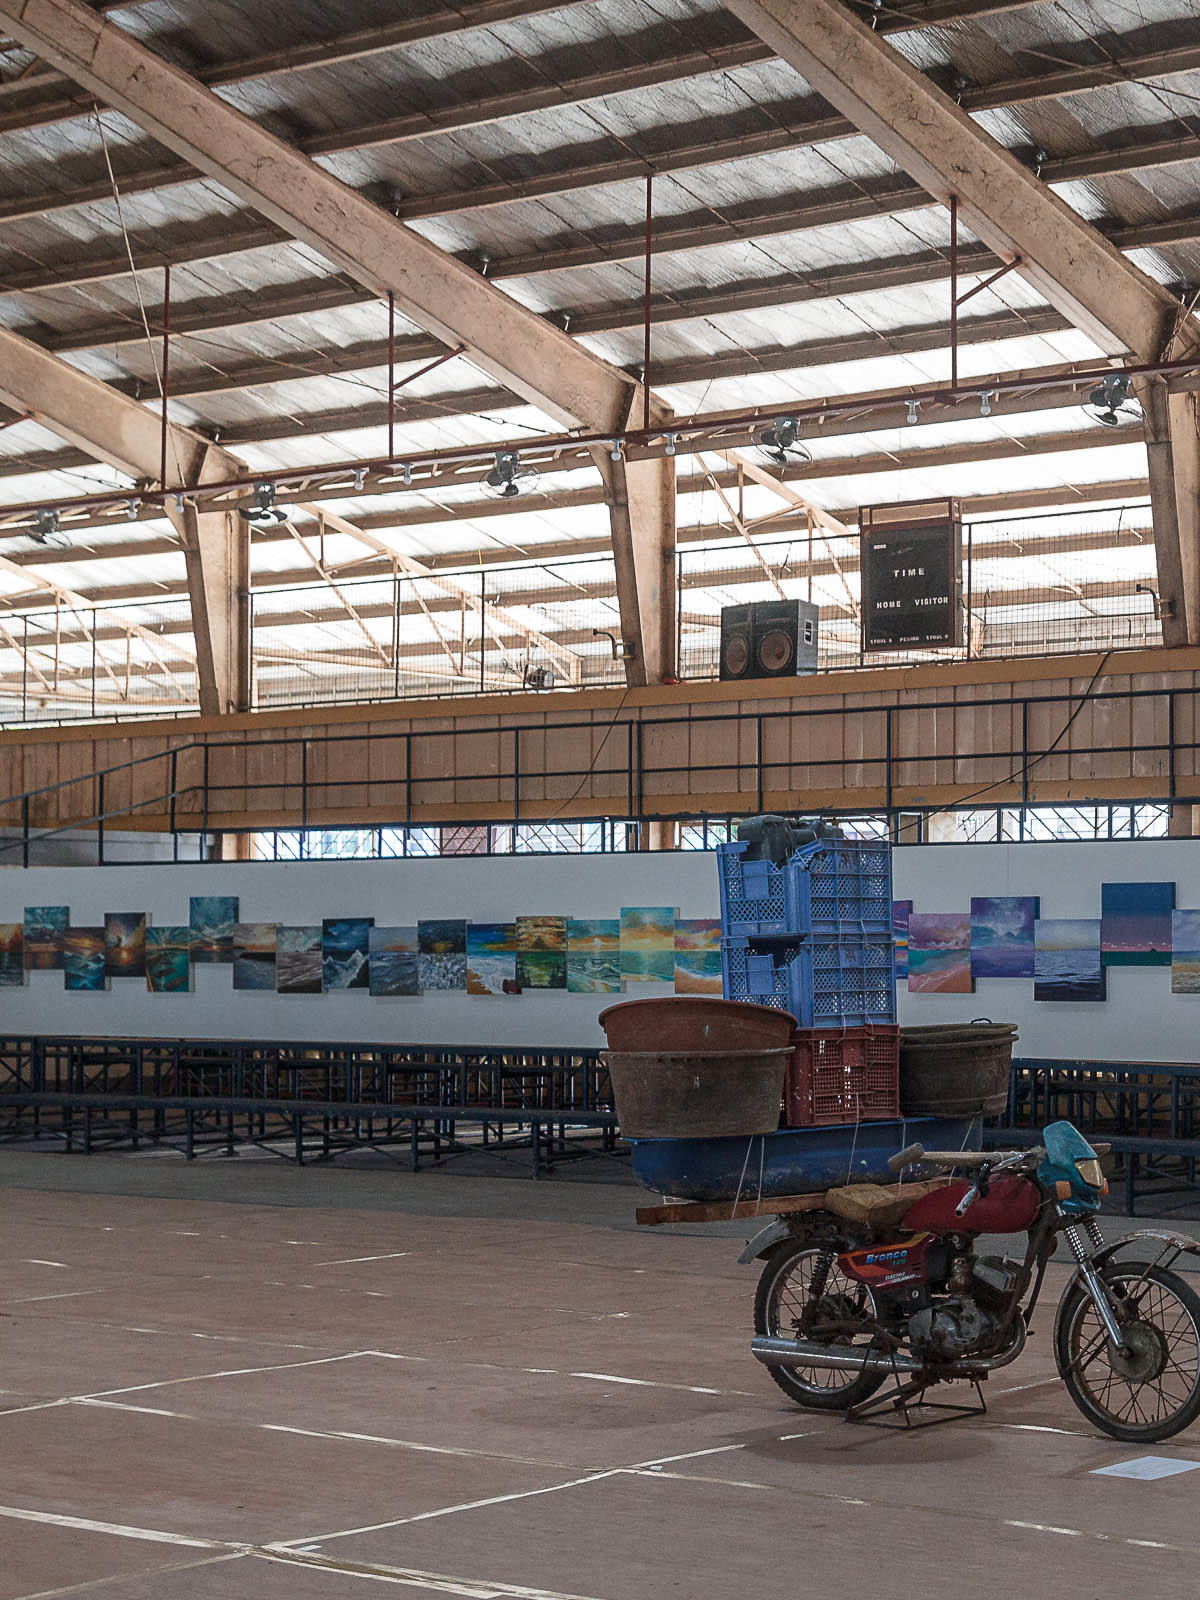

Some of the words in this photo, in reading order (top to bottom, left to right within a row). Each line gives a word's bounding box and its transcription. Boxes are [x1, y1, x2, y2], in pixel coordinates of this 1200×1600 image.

[893, 568, 925, 577] TIME
[876, 600, 902, 609] HOME
[915, 597, 949, 606] VISITOR
[866, 1250, 907, 1264] Bronco
